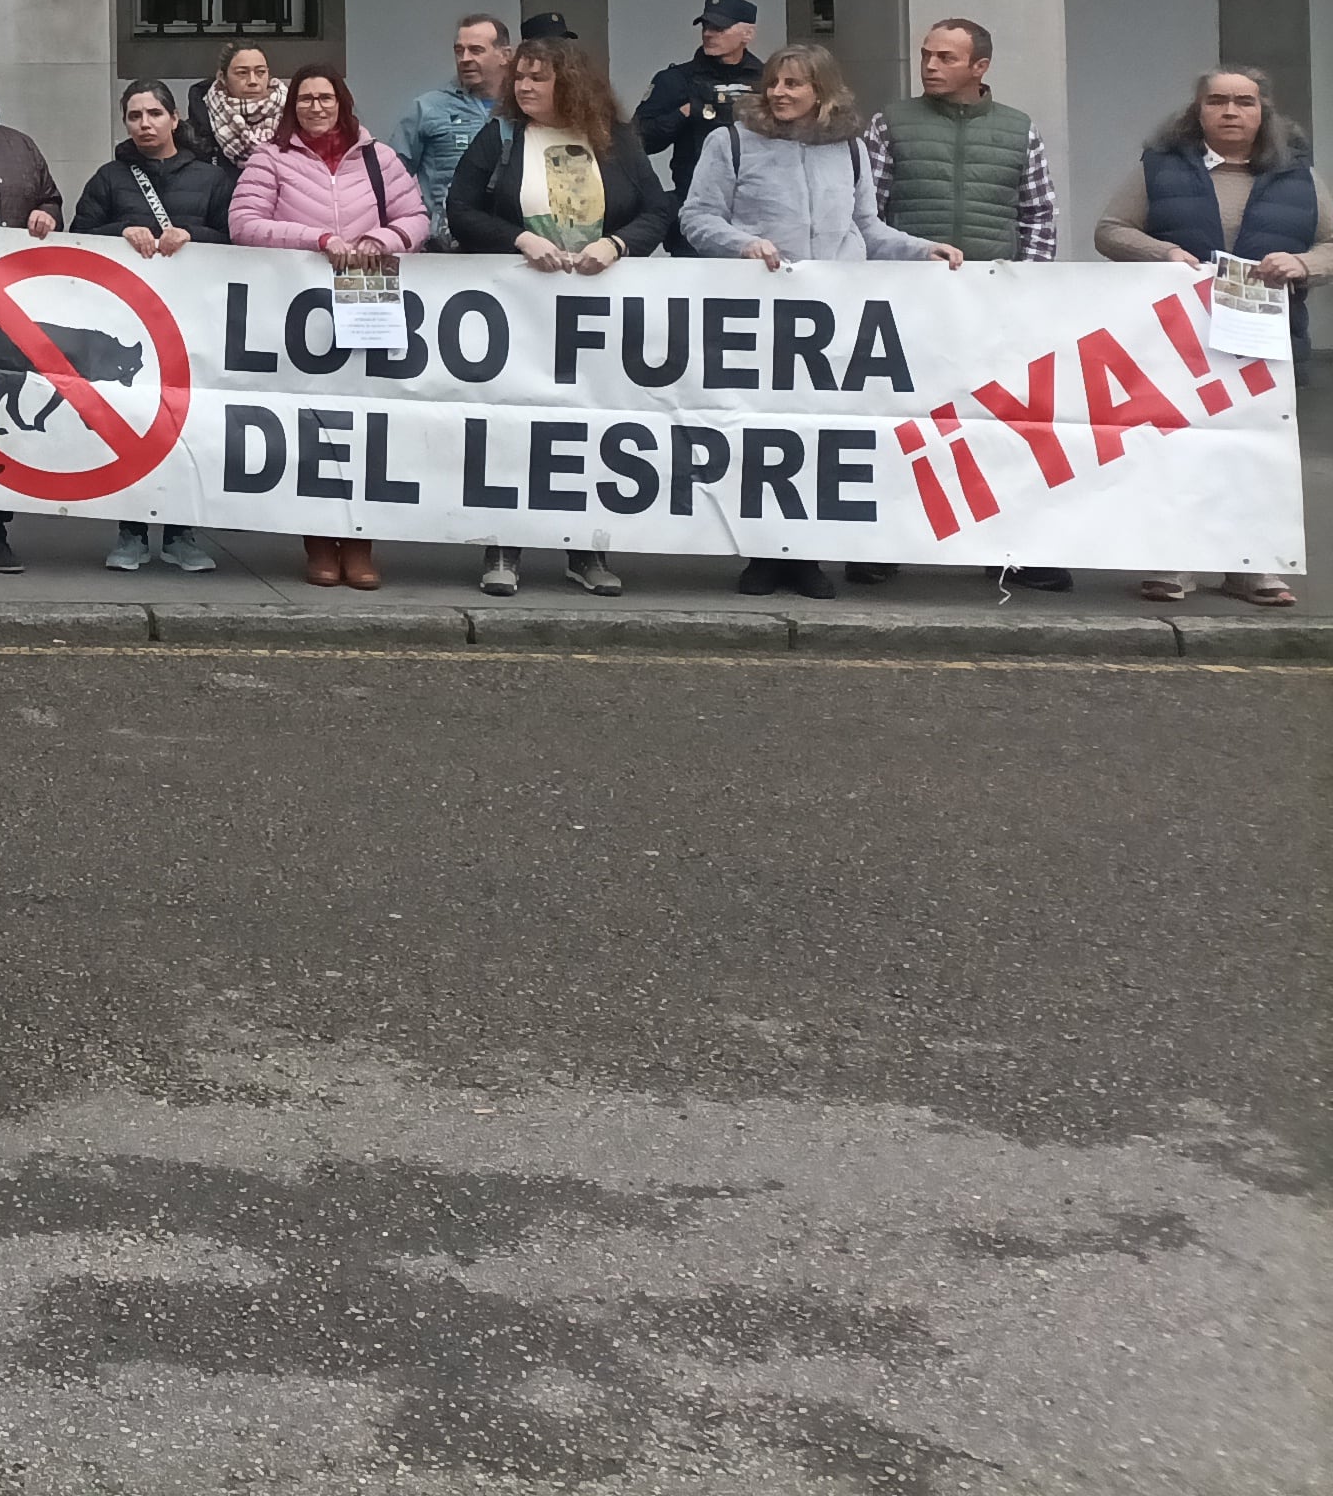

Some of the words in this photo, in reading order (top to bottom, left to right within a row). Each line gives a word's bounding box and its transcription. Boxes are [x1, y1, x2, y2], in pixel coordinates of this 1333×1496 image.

[555, 295, 915, 393] FUERA
[224, 404, 420, 505] DEL
[463, 417, 878, 522] LESPRE
